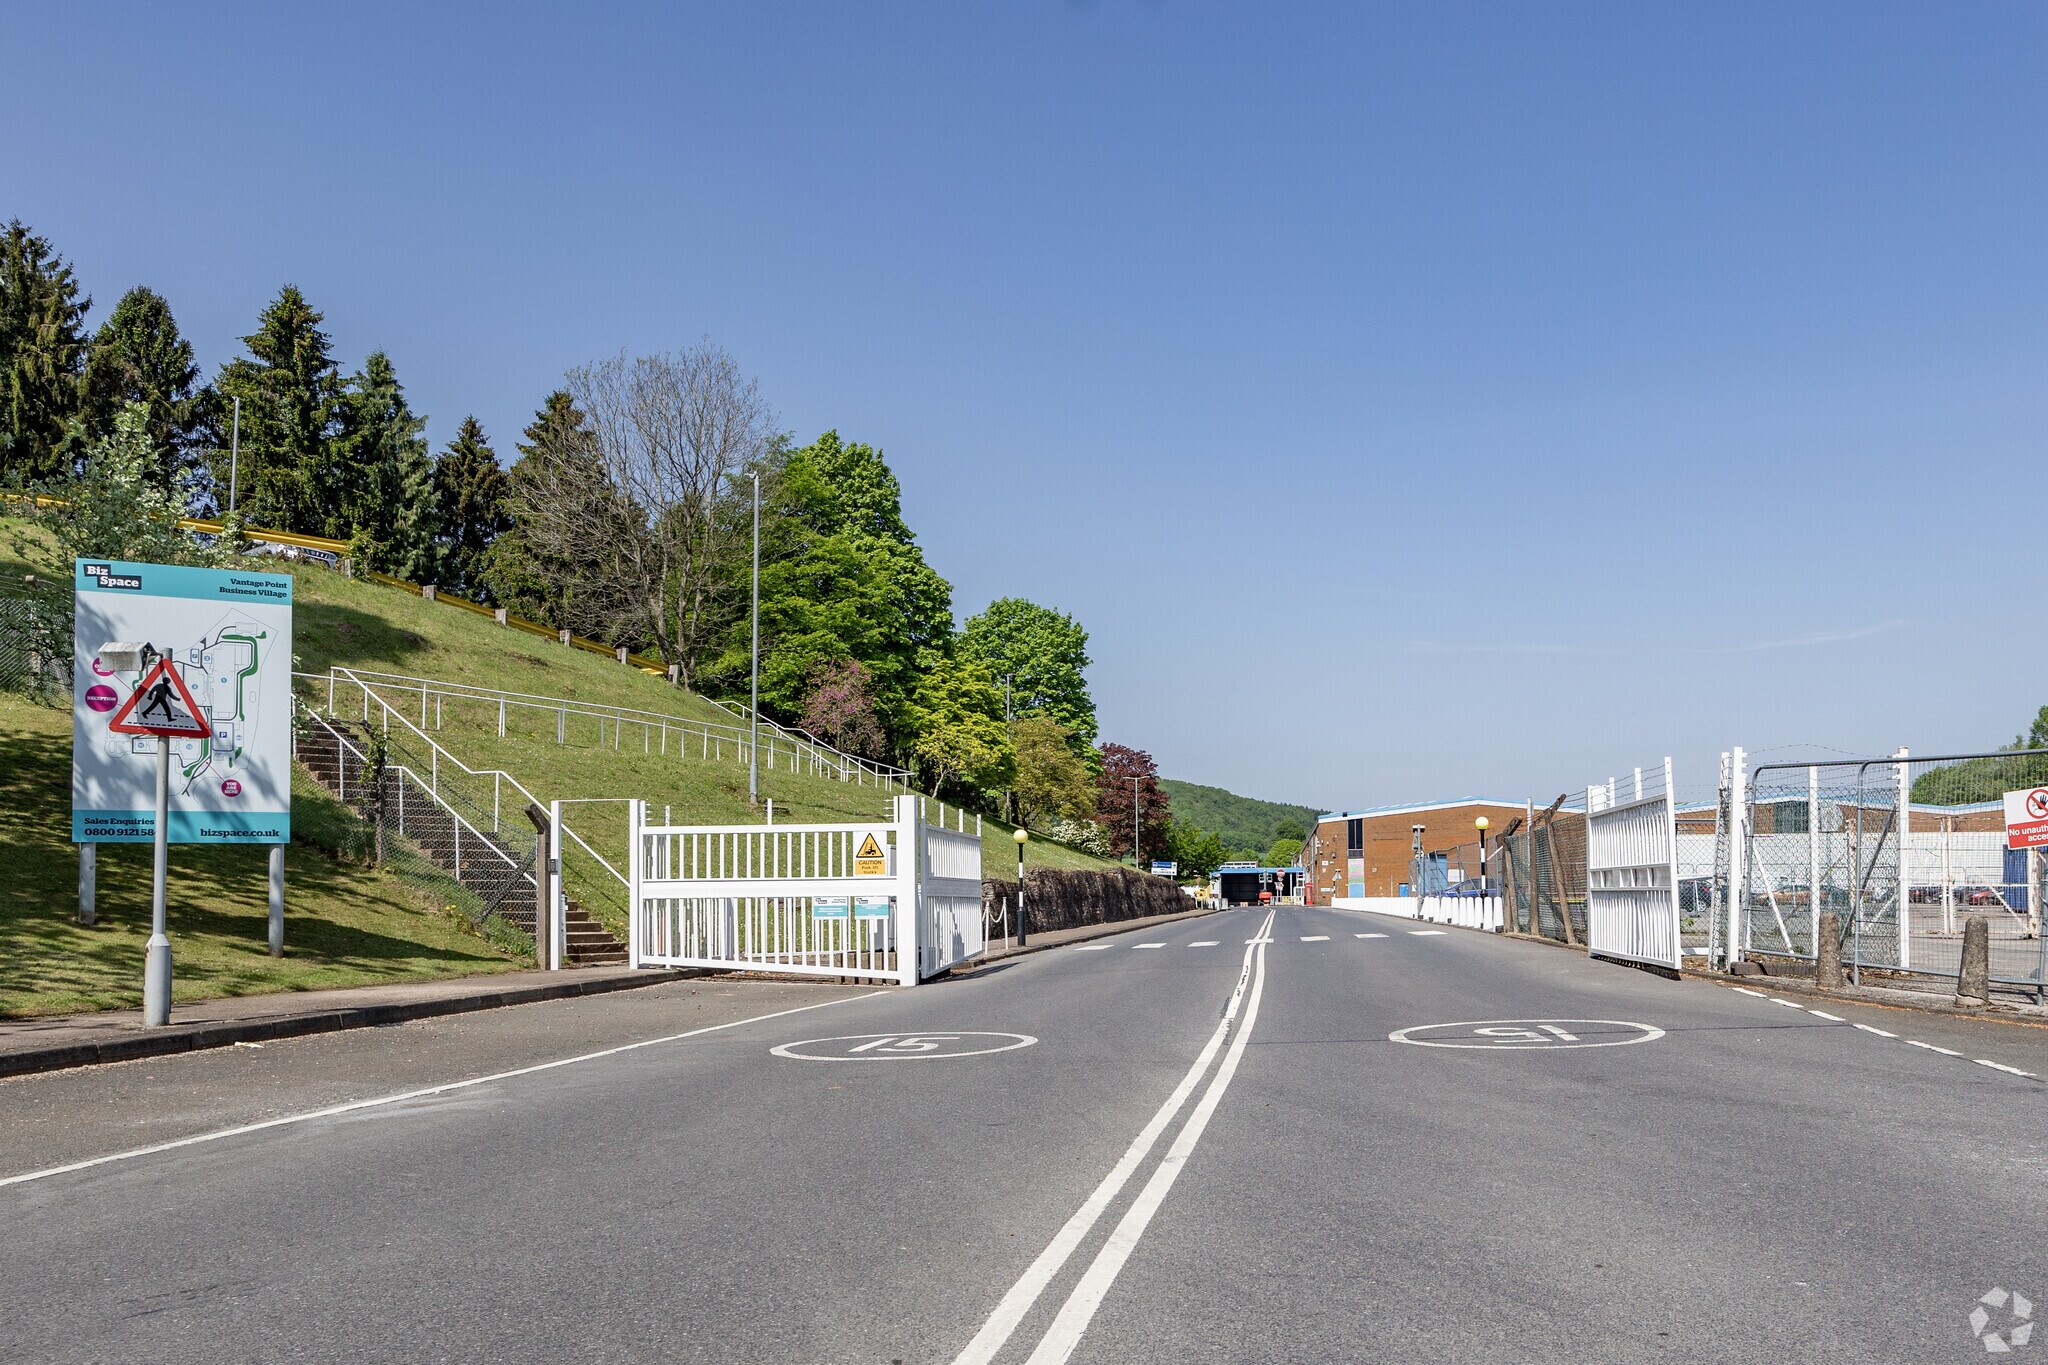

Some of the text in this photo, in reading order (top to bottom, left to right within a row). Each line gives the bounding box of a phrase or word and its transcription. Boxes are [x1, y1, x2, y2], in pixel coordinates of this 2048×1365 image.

[87, 565, 109, 576] Biz
[100, 576, 140, 587] Space
[230, 578, 288, 589] Vantage Point
[219, 586, 288, 599] Business Village
[84, 817, 155, 826] Sales Enquiries
[84, 828, 156, 836] 0800 9121 58
[200, 828, 280, 838] bizspace.co.uk
[2008, 828, 2020, 836] No
[1472, 1025, 1581, 1043] 15
[848, 1036, 960, 1053] 15
